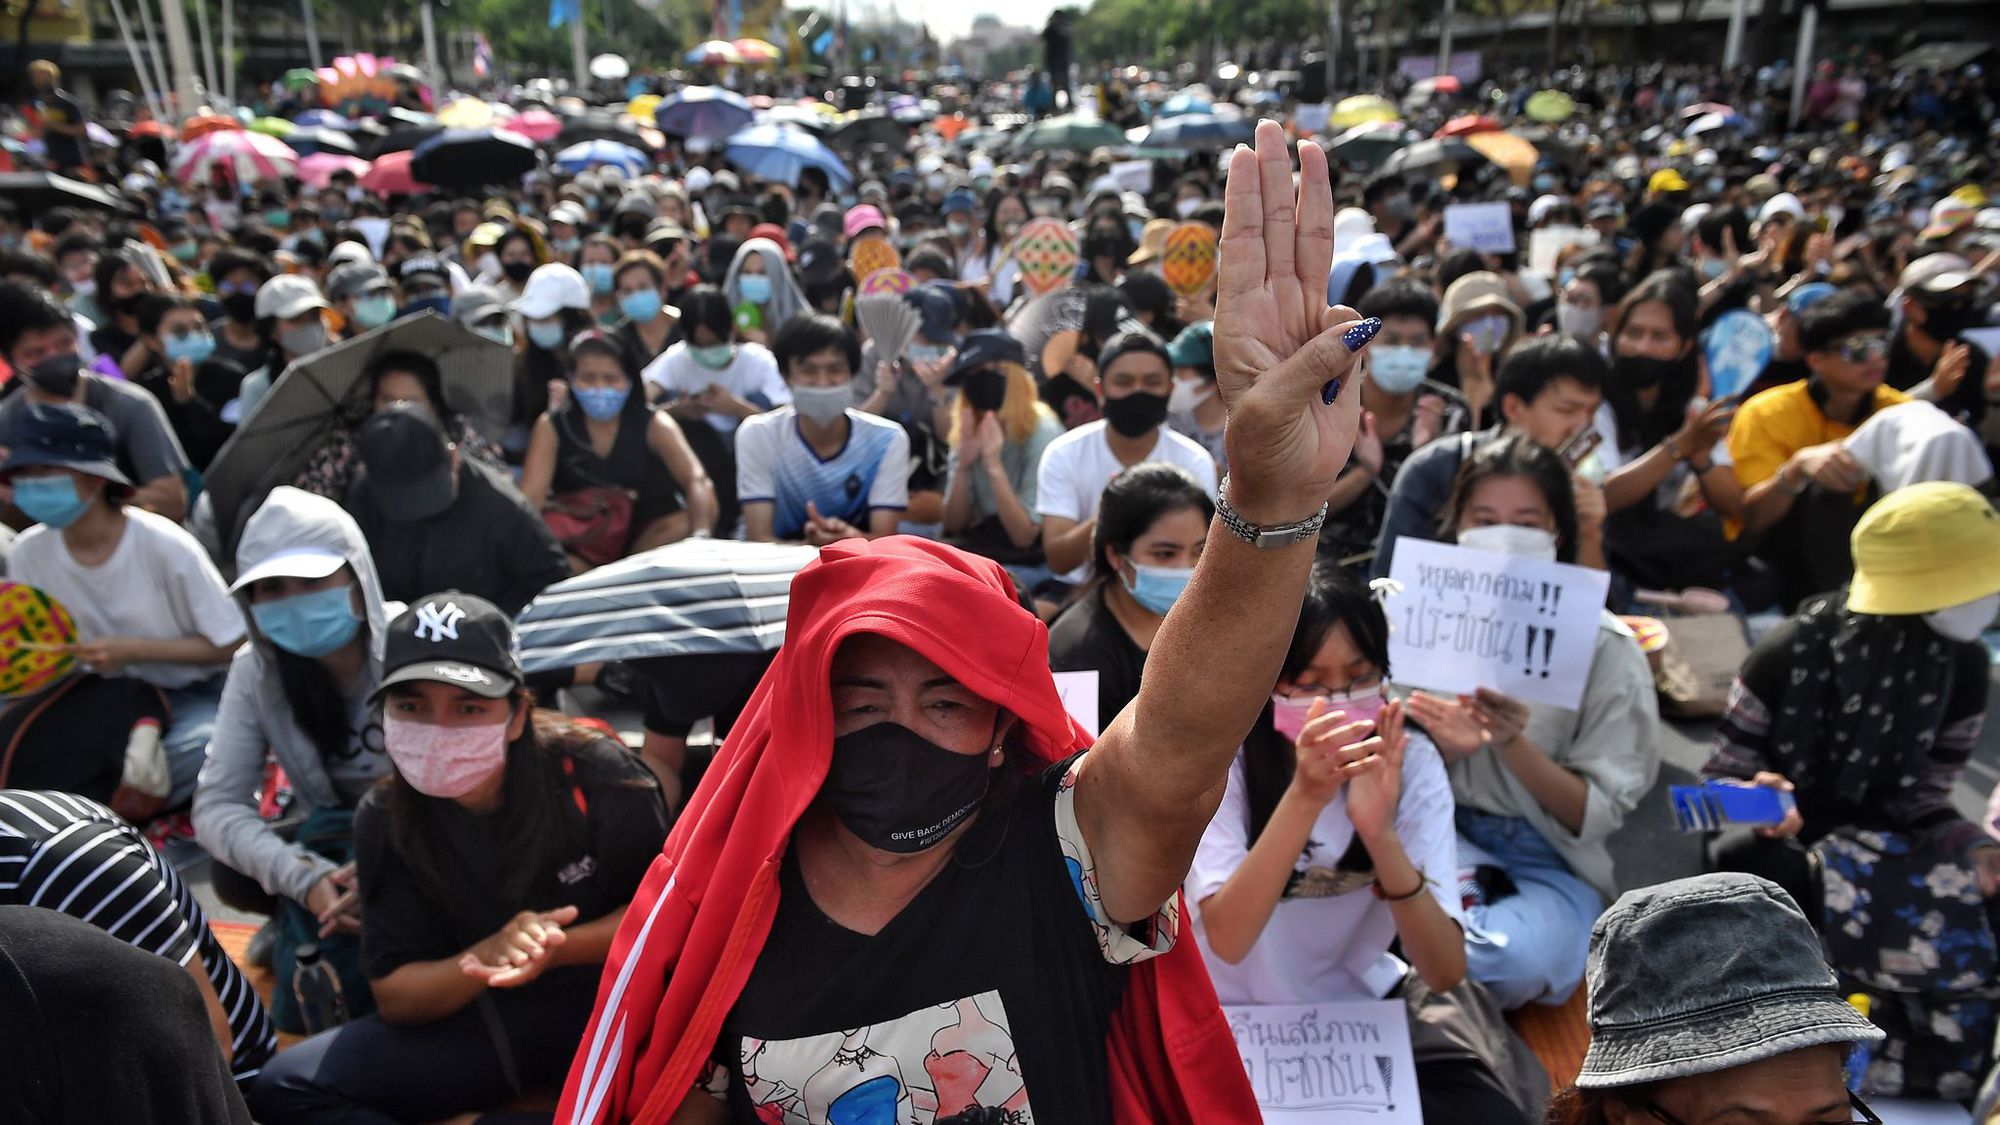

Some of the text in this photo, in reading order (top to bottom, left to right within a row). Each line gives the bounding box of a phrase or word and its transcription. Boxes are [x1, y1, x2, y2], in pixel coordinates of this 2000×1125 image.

[414, 601, 467, 642] NY
[891, 831, 915, 841] GIVE
[917, 823, 941, 838] BACK
